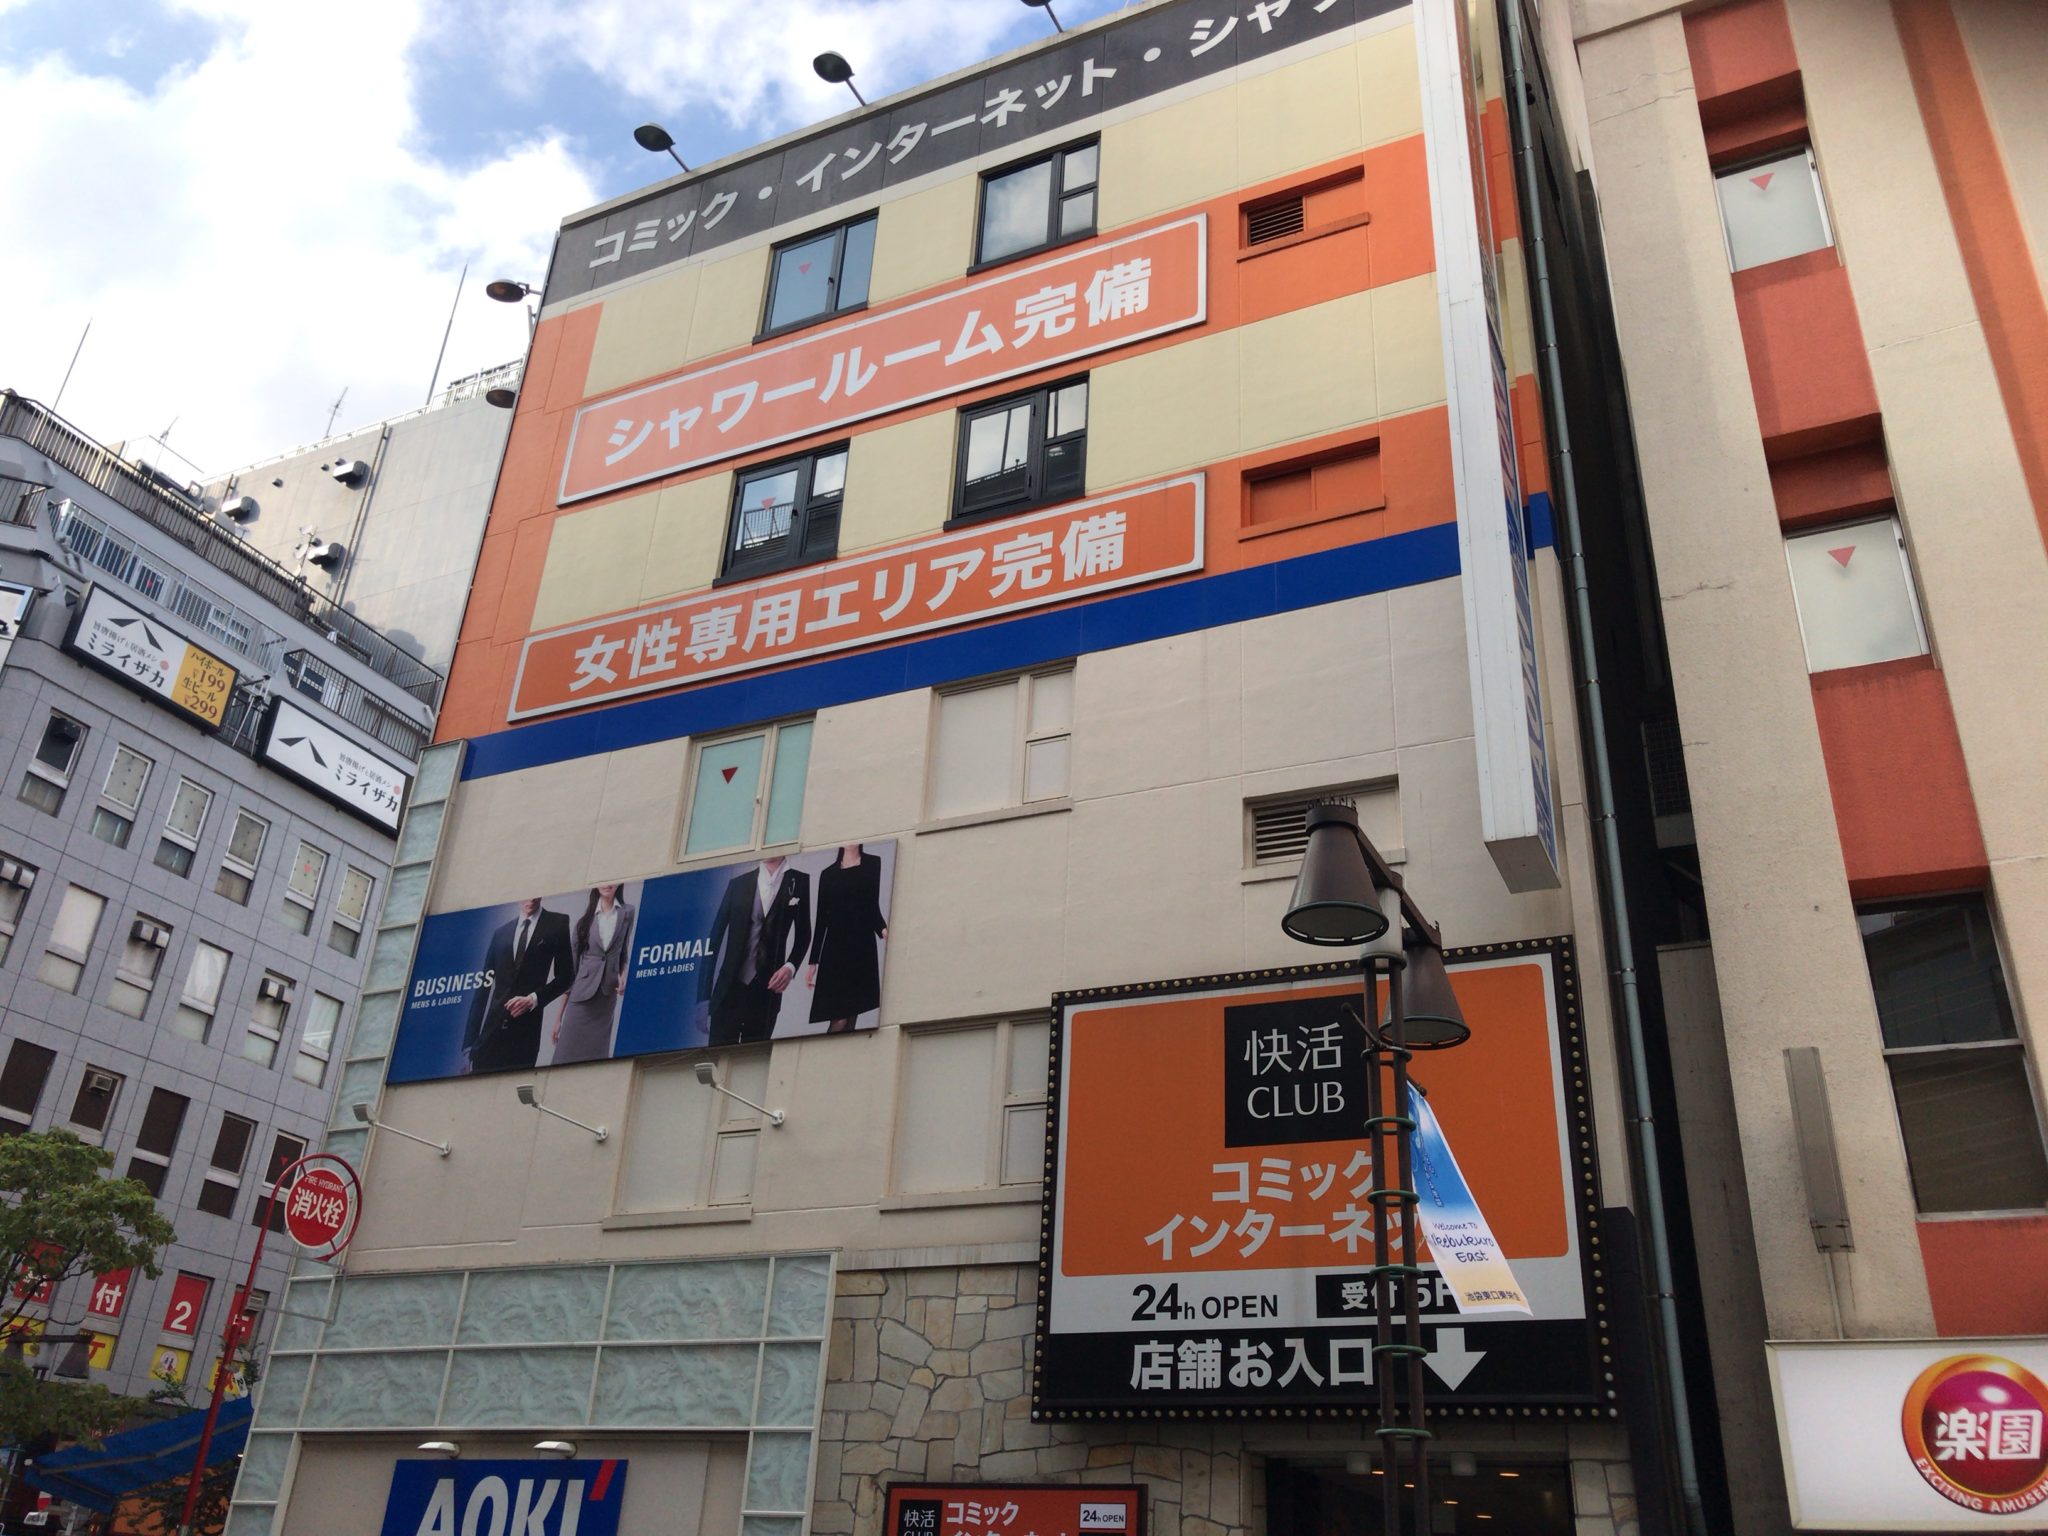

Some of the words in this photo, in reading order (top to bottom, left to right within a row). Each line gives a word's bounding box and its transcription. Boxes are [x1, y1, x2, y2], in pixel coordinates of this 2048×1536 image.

[605, 257, 1151, 466] シャワールーム完備
[569, 510, 1127, 697] 女性専用エリア完備
[88, 632, 165, 688] ミライザカ
[191, 652, 225, 677] ハイボール
[183, 676, 216, 702] 生ビール
[336, 764, 398, 812] ミライザカ
[636, 968, 658, 979] MENS
[659, 967, 665, 976] &
[667, 962, 695, 974] LADIES
[638, 937, 714, 966] FORMAL
[410, 1000, 430, 1010] MENS
[431, 998, 437, 1007] &
[438, 995, 462, 1006] LADIES
[414, 969, 495, 998] BUSINESS
[1243, 1021, 1343, 1077] 快活
[1246, 1081, 1345, 1119] CLUB
[305, 1174, 319, 1186] FIRE
[319, 1179, 345, 1194] HYDRANT
[1212, 1150, 1373, 1204] コミック
[291, 1187, 345, 1229] 消火栓
[1456, 1251, 1489, 1263] East
[1131, 1283, 1196, 1321] 24h
[1201, 1294, 1278, 1319] OPEN
[1130, 1338, 1374, 1390] 店舗お入口
[1935, 1407, 2043, 1461] 楽園
[1915, 1457, 1984, 1510] EXCITING
[416, 1475, 586, 1536] AOKI
[903, 1509, 936, 1528] 快活
[946, 1501, 1020, 1527] コミック
[1102, 1514, 1124, 1523] OPEN
